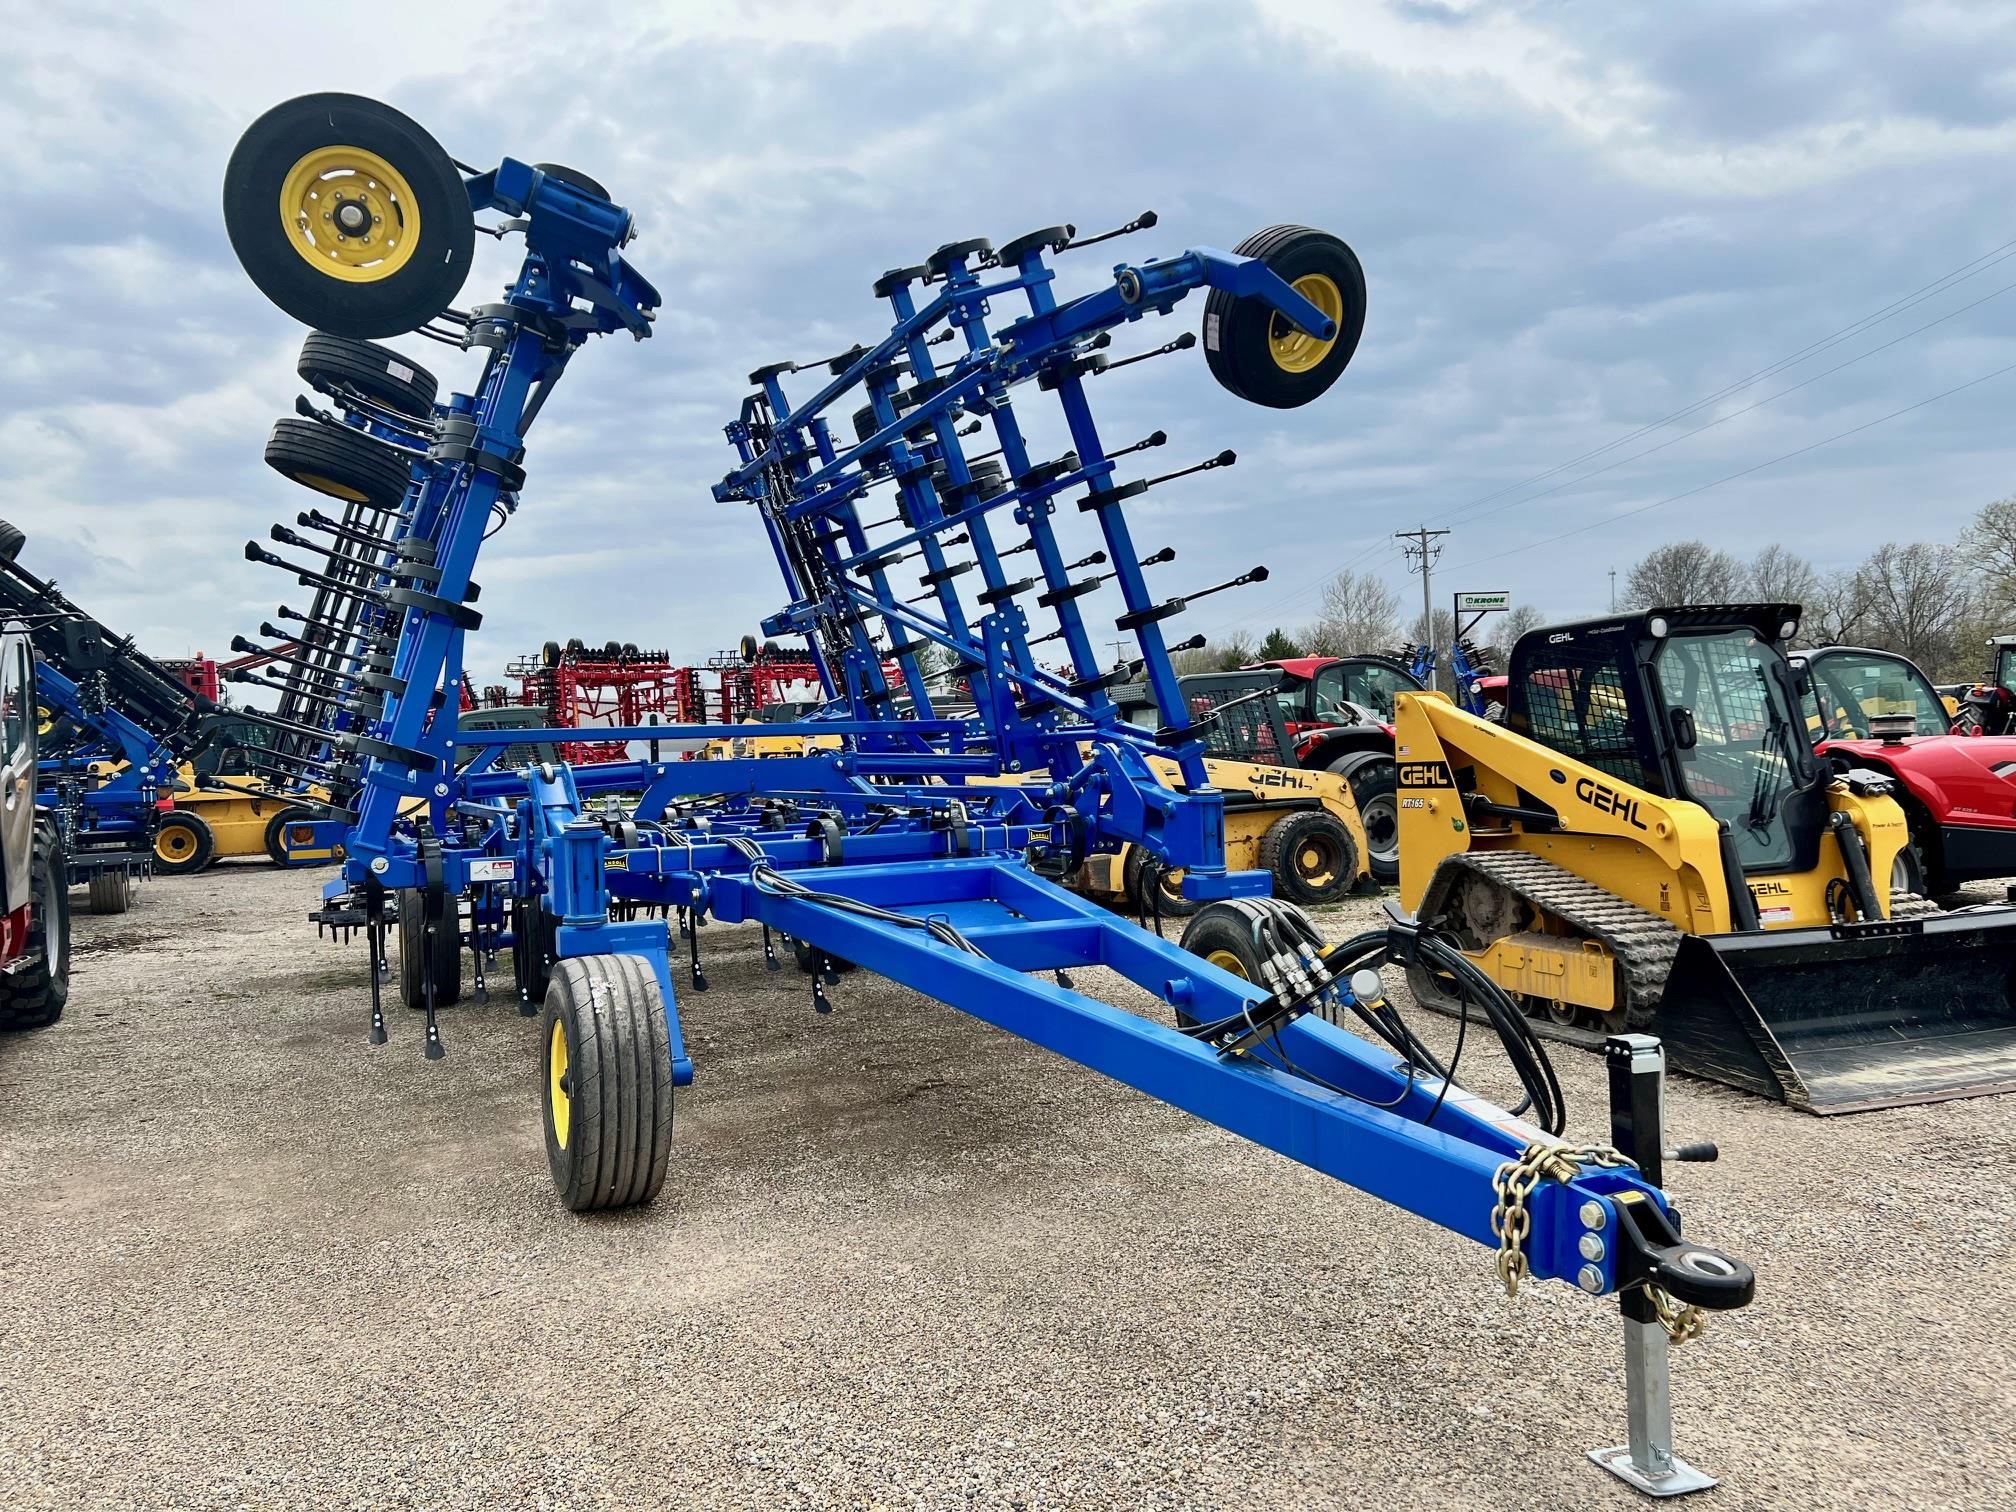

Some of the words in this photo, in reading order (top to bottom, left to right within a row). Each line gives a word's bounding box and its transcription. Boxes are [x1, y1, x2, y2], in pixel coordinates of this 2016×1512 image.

[1549, 632, 1575, 644] GEHL
[1400, 766, 1448, 785] GEHL
[1402, 798, 1424, 808] RT165
[1576, 777, 1648, 831] GEHL
[604, 859, 626, 869] ANDOLL
